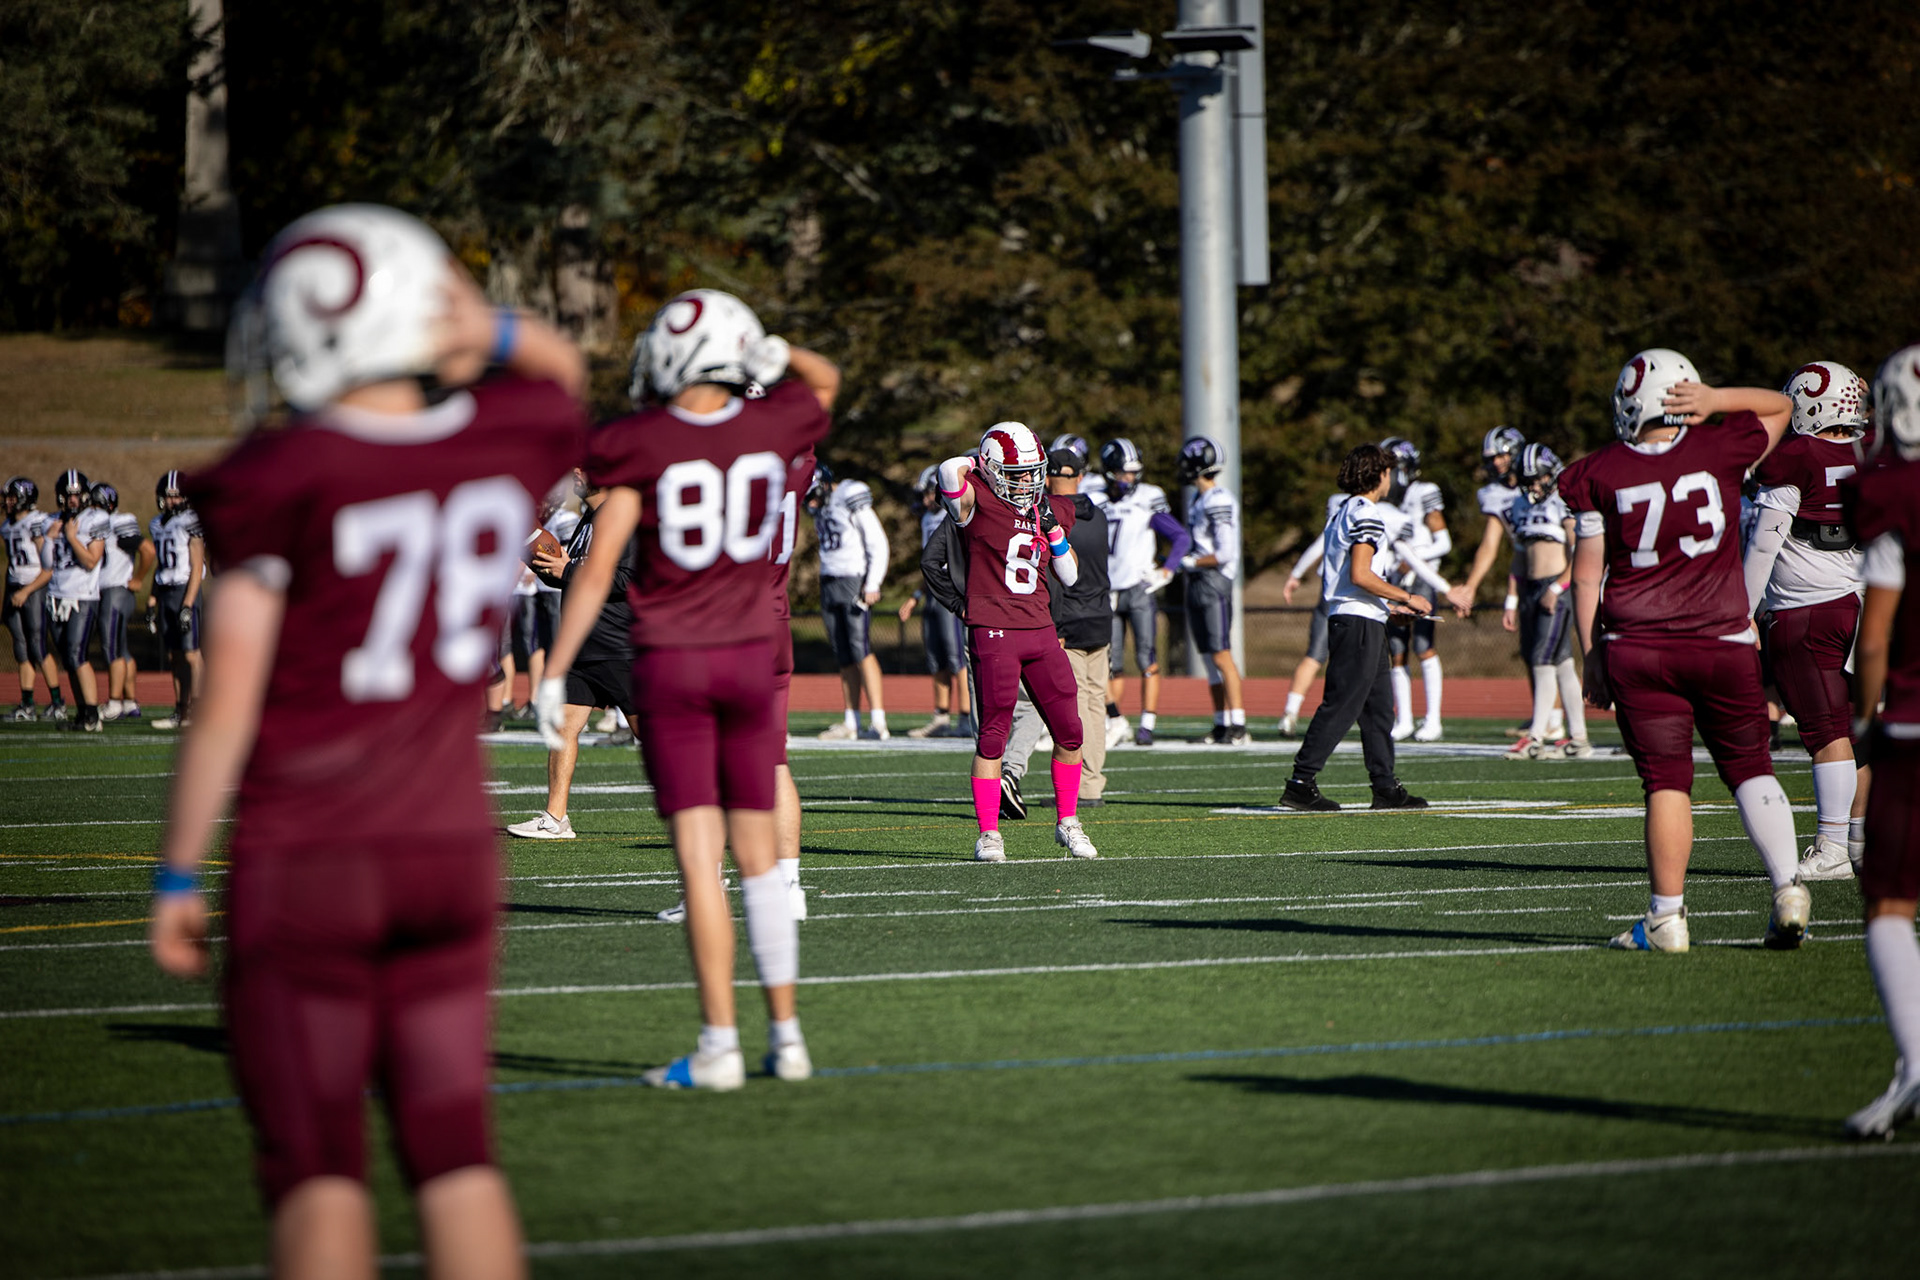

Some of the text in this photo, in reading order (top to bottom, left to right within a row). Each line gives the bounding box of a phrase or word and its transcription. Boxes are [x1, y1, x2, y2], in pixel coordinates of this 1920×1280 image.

[656, 451, 786, 571] 80
[1005, 532, 1041, 595] 8
[1615, 470, 1726, 568] 73
[332, 474, 536, 704] 78
